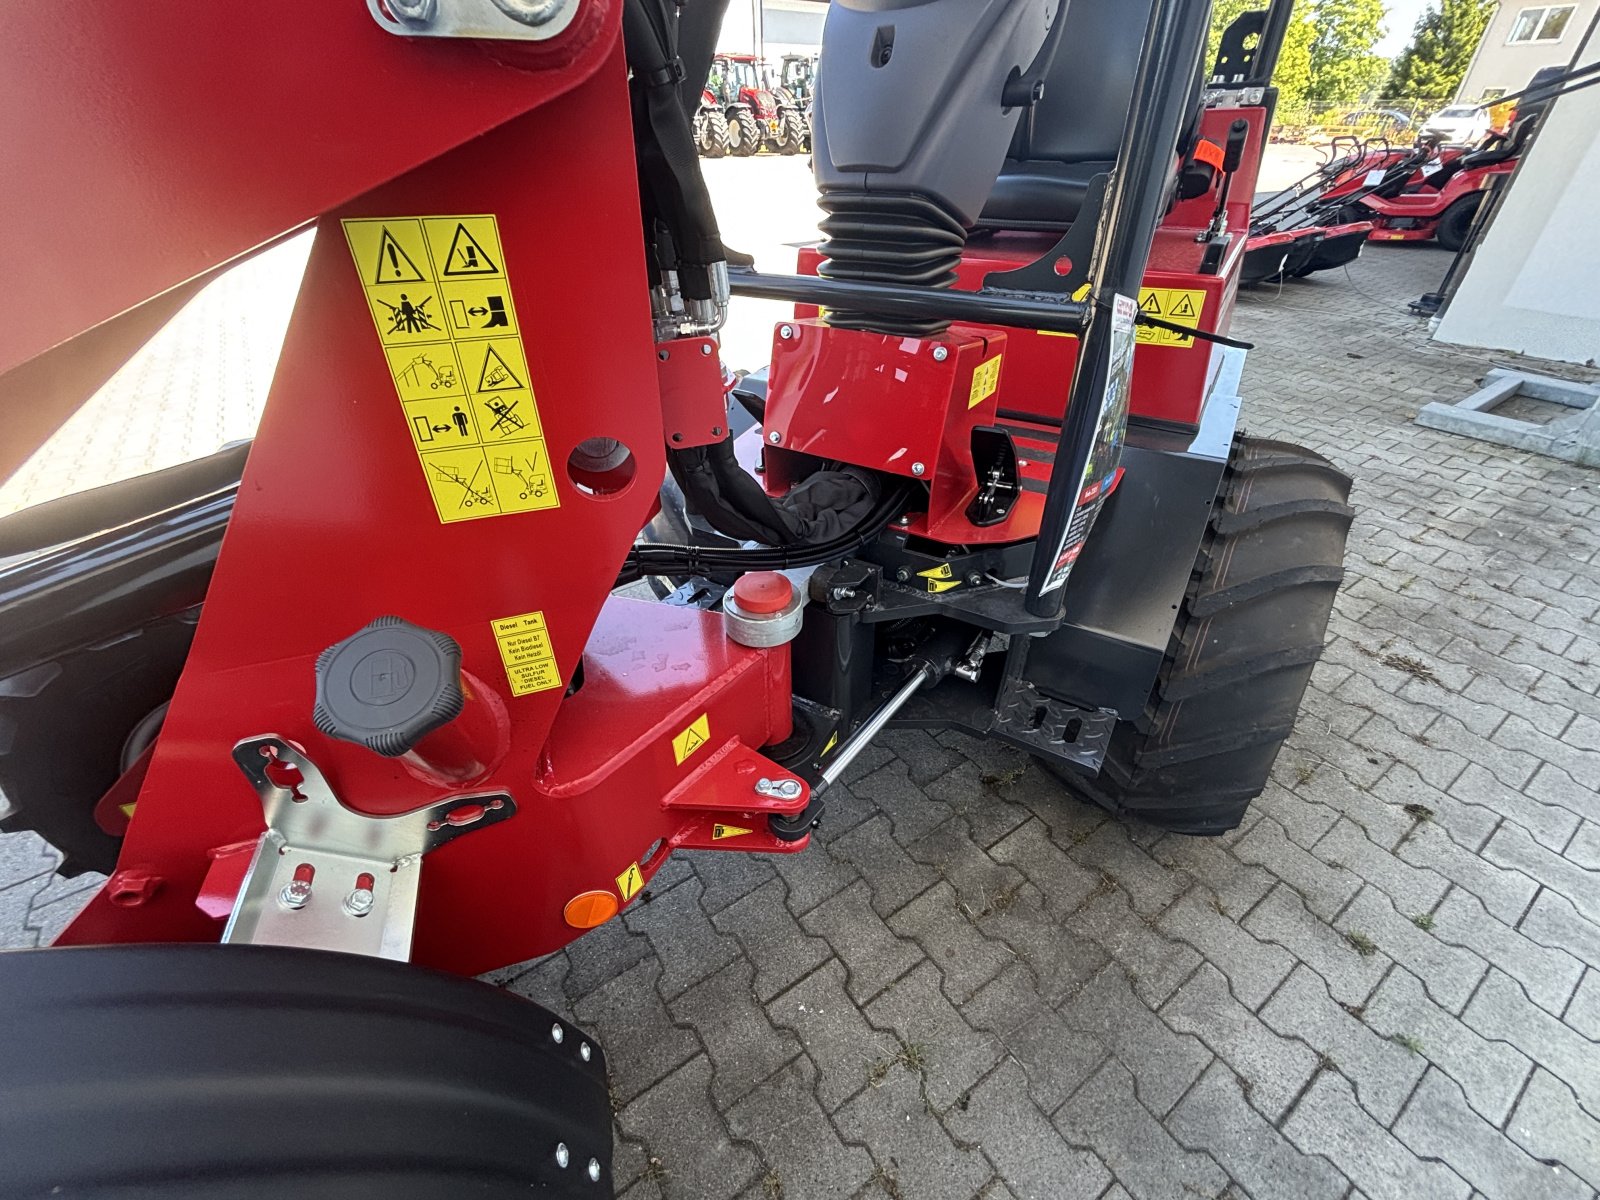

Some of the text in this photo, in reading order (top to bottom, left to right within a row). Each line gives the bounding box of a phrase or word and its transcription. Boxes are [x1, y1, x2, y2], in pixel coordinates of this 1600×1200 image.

[500, 622, 518, 630] Diesel
[521, 642, 544, 653] Biodiesel
[521, 670, 545, 678] SULFUR
